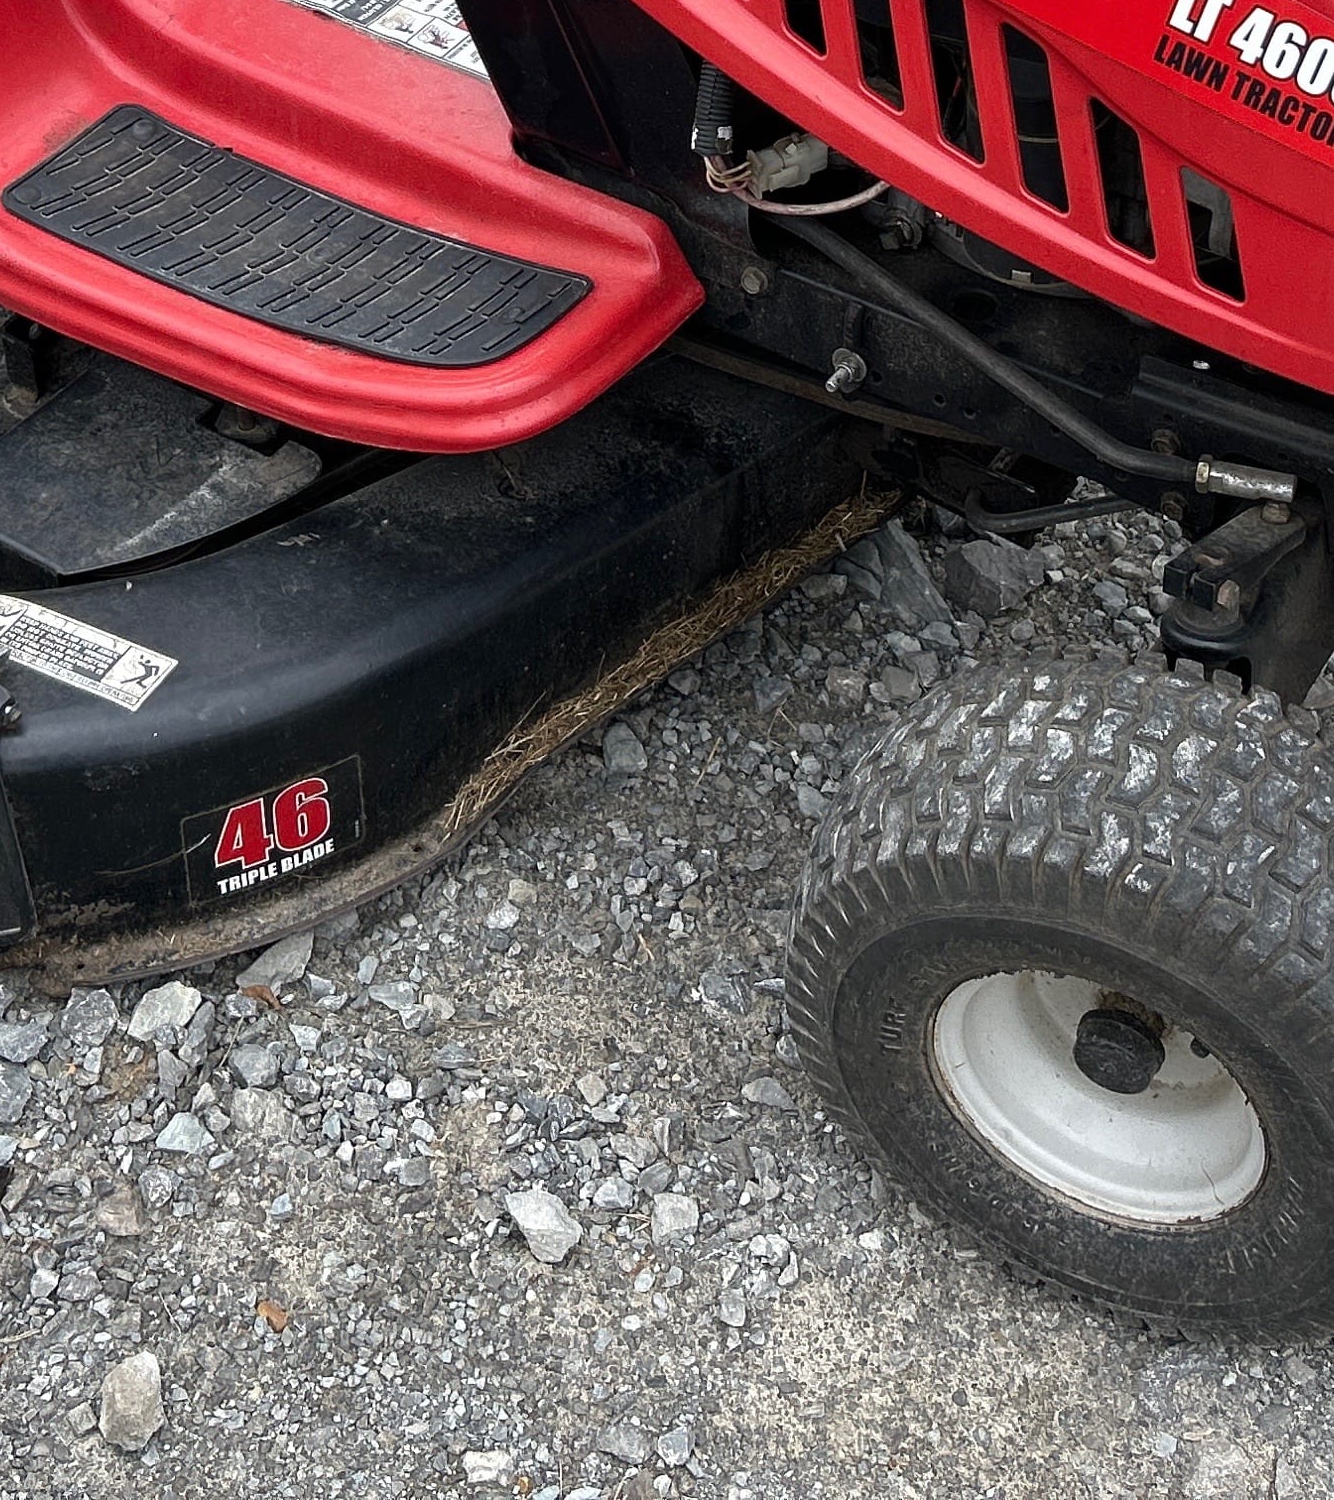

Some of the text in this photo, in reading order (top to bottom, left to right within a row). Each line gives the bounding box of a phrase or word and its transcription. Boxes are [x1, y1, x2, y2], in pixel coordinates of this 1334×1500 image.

[1153, 34, 1229, 92] LAWN
[214, 777, 331, 869] 46
[217, 838, 335, 895] TRIPLE BLADE
